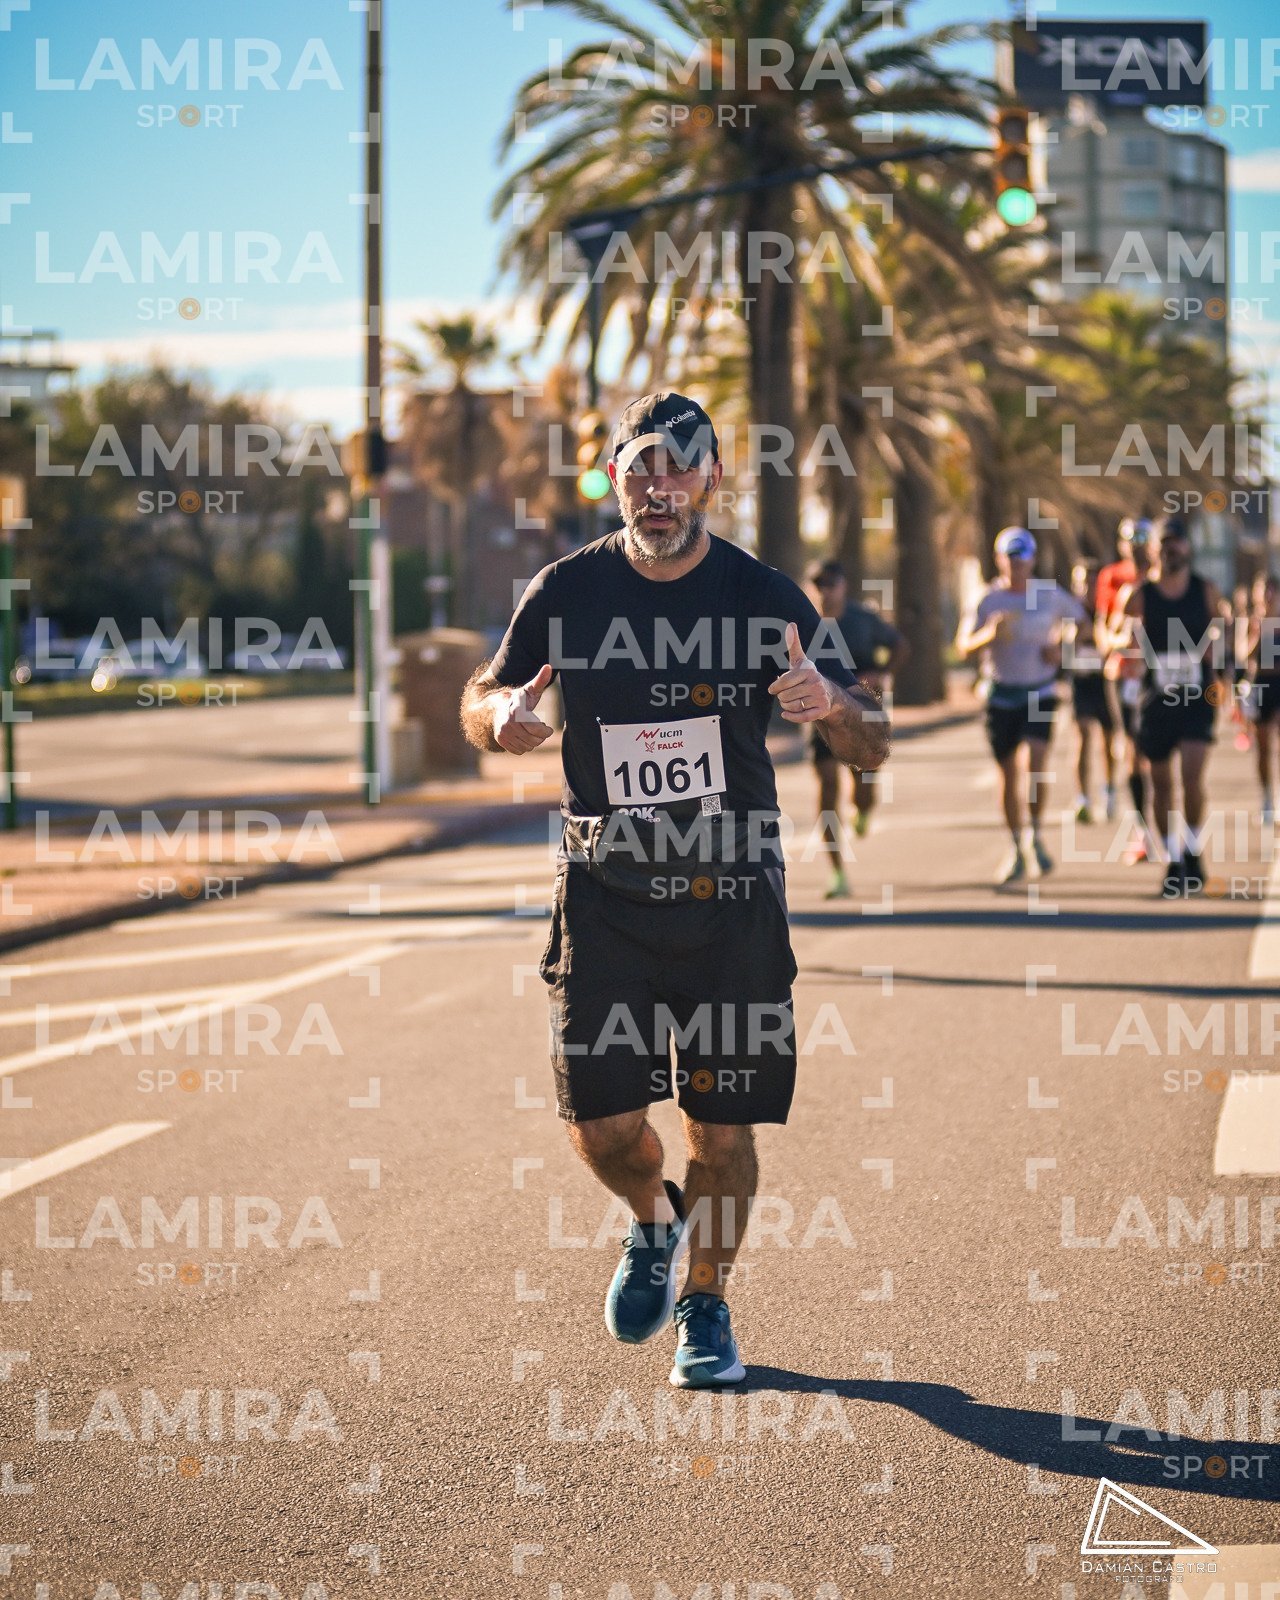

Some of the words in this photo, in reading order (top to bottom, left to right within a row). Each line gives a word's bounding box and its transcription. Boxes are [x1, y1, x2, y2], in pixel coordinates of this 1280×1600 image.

[659, 729, 683, 739] ucm
[657, 741, 684, 750] FALCK
[613, 751, 713, 798] 1061
